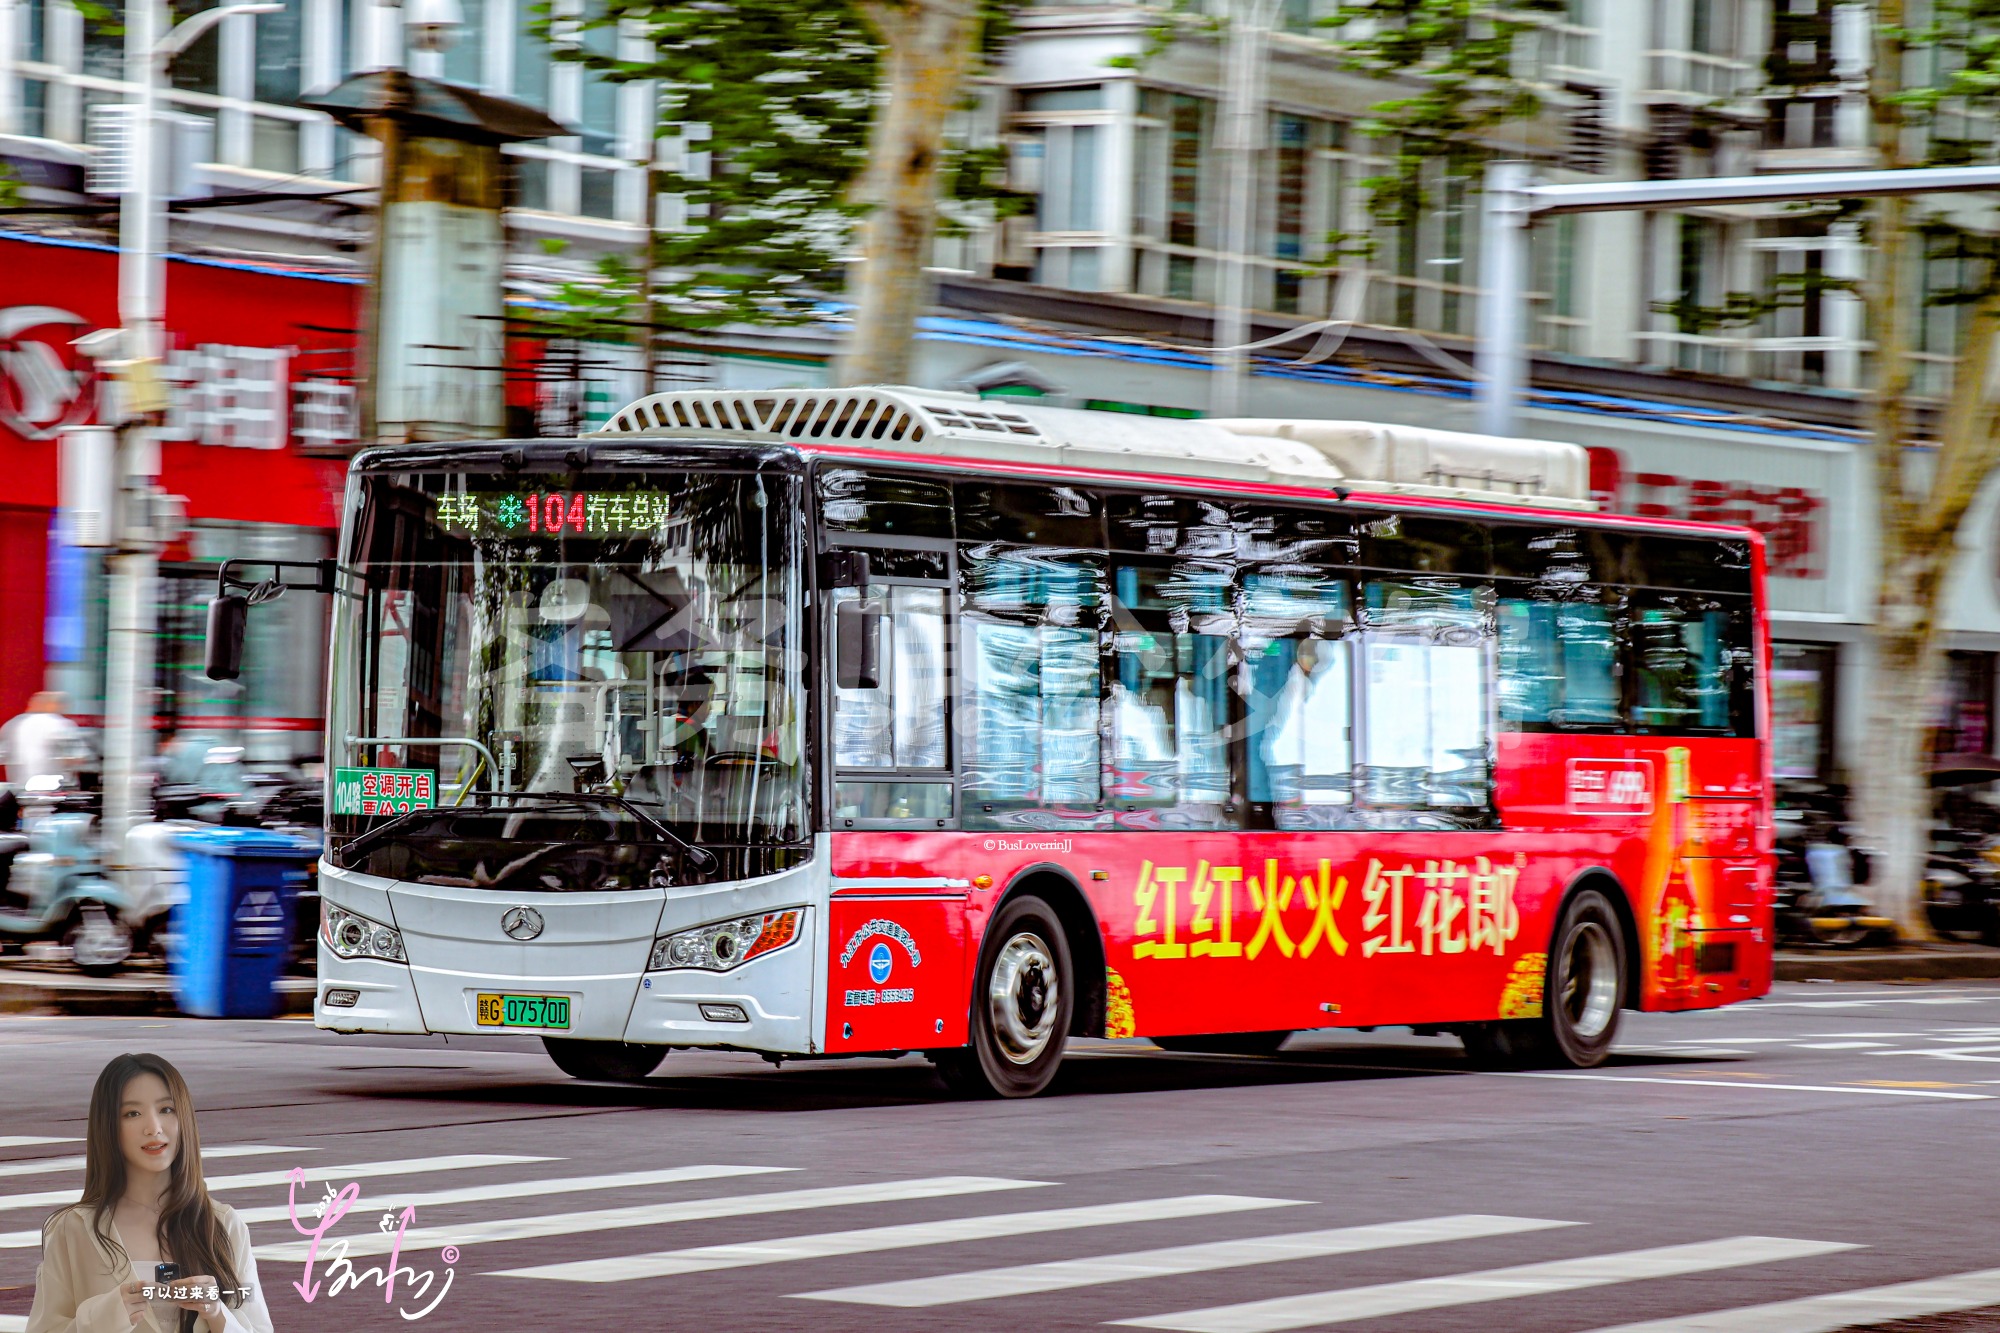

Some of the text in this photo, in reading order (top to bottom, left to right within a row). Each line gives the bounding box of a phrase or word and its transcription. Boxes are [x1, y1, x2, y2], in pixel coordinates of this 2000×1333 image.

[436, 493, 480, 531] 车场
[525, 493, 586, 532] 104
[362, 773, 431, 799] 空调开启
[1132, 855, 1521, 960] 红红火火 红花郎
